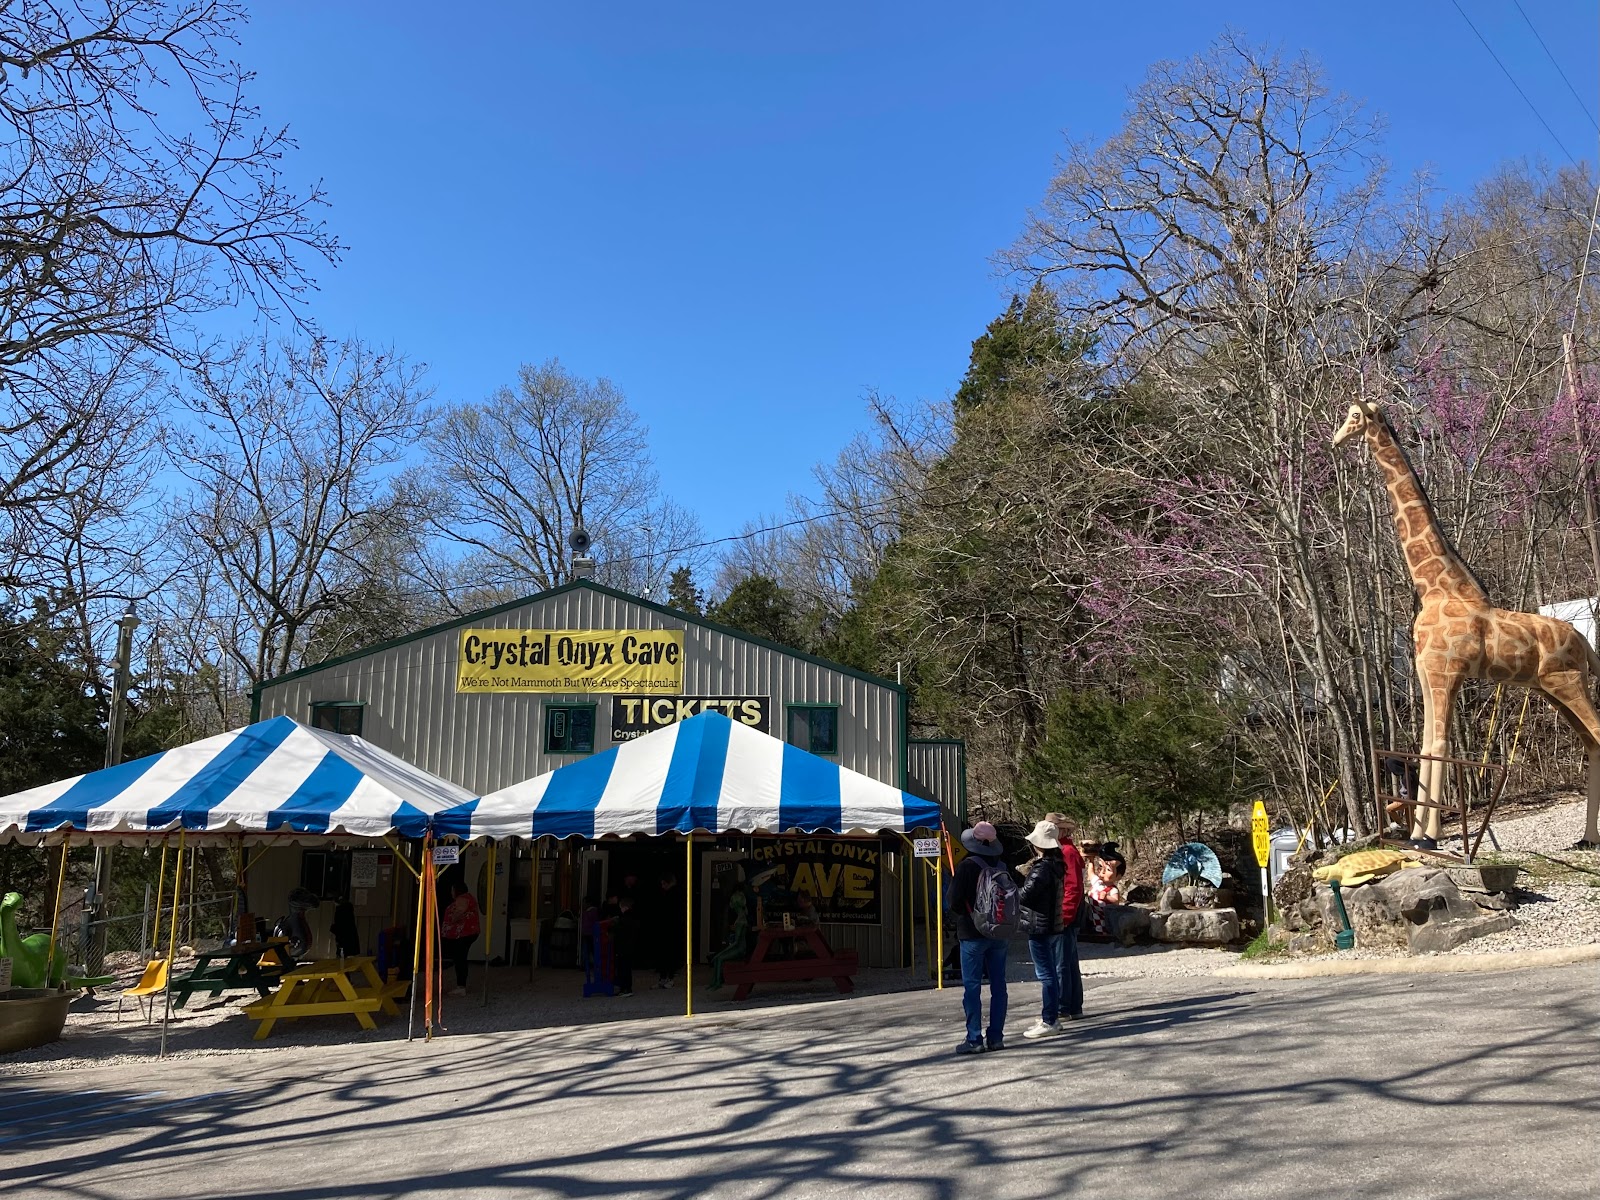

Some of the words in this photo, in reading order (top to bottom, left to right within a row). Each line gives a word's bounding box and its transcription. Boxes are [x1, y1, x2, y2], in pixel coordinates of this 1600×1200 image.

[464, 634, 550, 670] Crystal
[557, 636, 614, 670] Onyx
[621, 635, 679, 666] Cave
[461, 677, 489, 687] We're
[491, 677, 509, 687] Not
[511, 677, 562, 687] Mammoth
[564, 677, 580, 687] But
[580, 677, 597, 687] We
[600, 677, 618, 687] Are
[620, 677, 680, 690] Spectacular
[753, 841, 825, 861] CRYSTAL
[831, 842, 879, 865] ONYX
[774, 862, 875, 899] AVE
